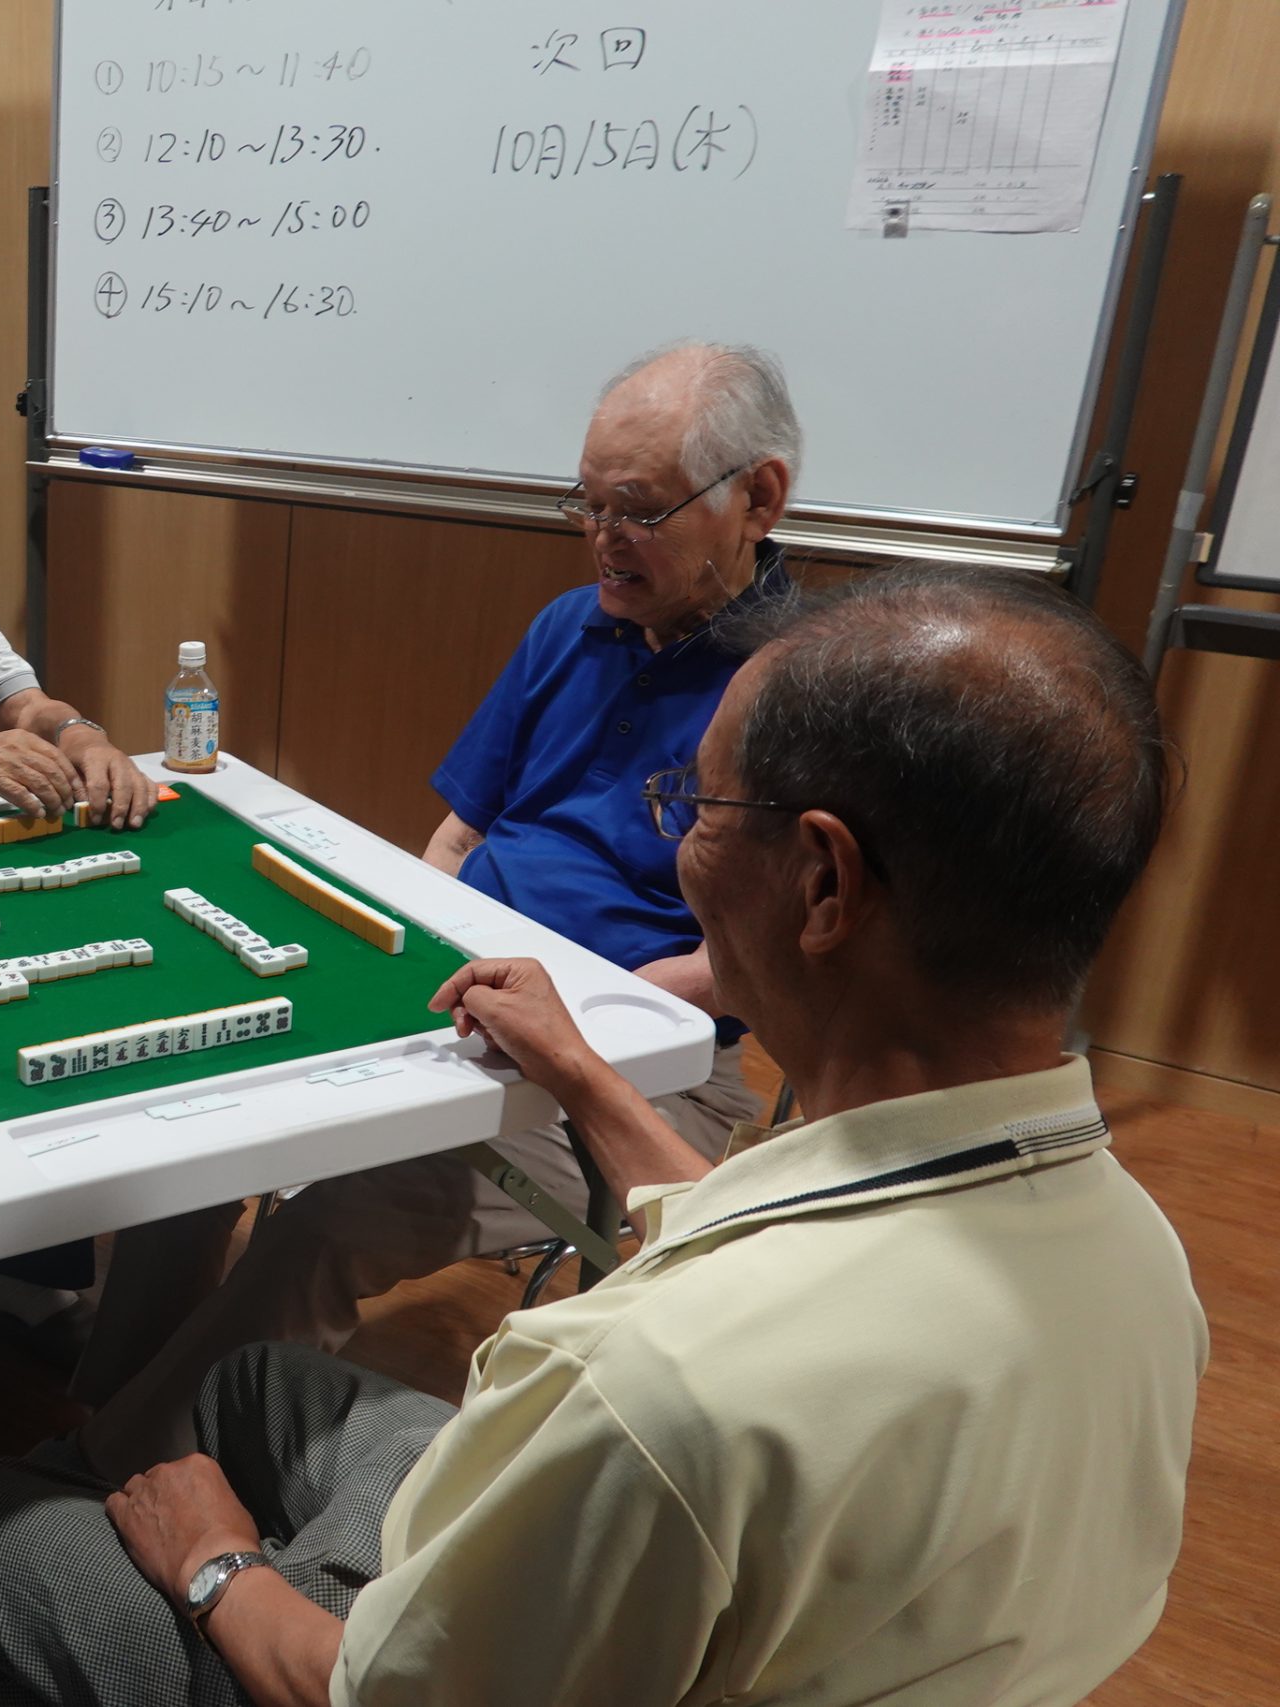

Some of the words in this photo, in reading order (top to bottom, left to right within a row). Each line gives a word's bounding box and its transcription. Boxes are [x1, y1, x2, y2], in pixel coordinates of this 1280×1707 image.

[529, 27, 647, 73] 次回
[489, 104, 760, 181] 10月15日(木)
